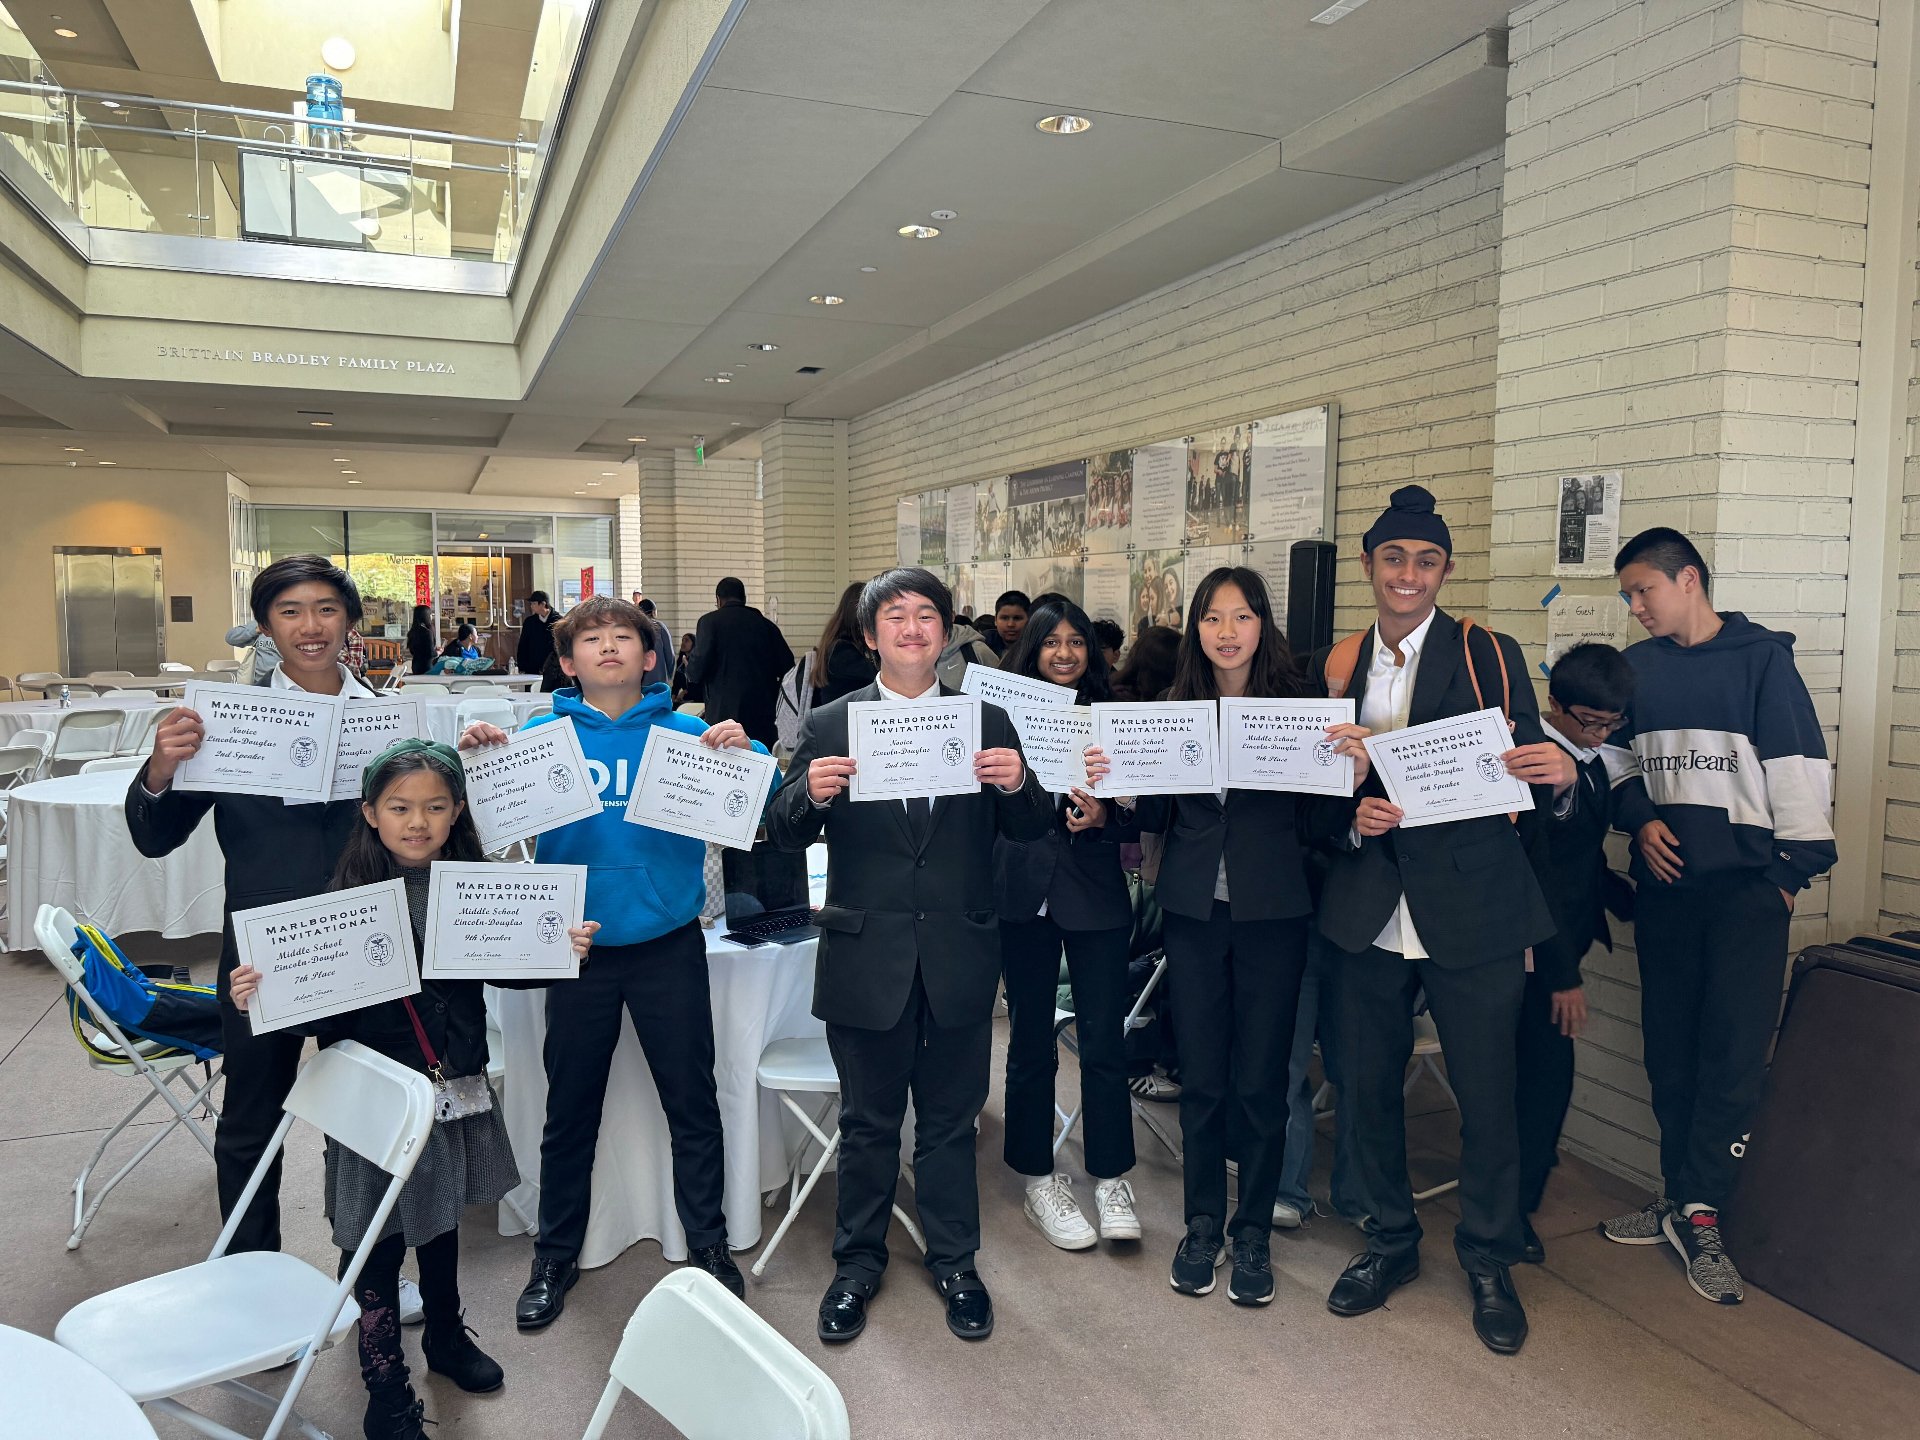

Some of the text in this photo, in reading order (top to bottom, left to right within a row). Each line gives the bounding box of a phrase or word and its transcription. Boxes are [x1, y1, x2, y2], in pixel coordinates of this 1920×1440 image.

[158, 346, 456, 374] BRITTAIN BRADLEY FAMILY PLAZA
[387, 556, 430, 564] Welcome
[1576, 606, 1595, 616] Guest
[212, 701, 314, 718] MARLBOROUGH
[214, 711, 310, 727] INVITATIONAL
[342, 714, 400, 724] BOROUGH
[872, 714, 958, 725] MARLBOROUGH
[1025, 716, 1092, 727] MARLBOROUG
[230, 726, 257, 735] Novice
[343, 724, 398, 733] ATIONAL
[874, 723, 955, 734] INVITATIONAL
[1026, 723, 1090, 735] INVITATIONA
[1245, 723, 1325, 731] INVITATIONAL
[206, 736, 277, 747] Lincoln-Douglas
[1242, 743, 1300, 751] Lincoln-Douglas
[1391, 730, 1482, 754] MARLBOROUGH
[872, 747, 930, 756] Lincoln-Douglas
[1398, 739, 1483, 761] INVITATIONAL
[232, 752, 265, 761] Speaker
[465, 741, 554, 775] MARLBOROUGH
[666, 747, 750, 774] MARLBOROUGH
[470, 752, 554, 782] INVITATIONAL
[667, 756, 745, 781] INVITATIONAL
[1405, 757, 1457, 772] Middle School
[678, 773, 700, 783] Novice
[1405, 767, 1464, 781] Lincoln-Douglas
[492, 778, 515, 790] Novice
[658, 778, 715, 796] Lincoln-Douglas
[1433, 781, 1460, 791] Speaker
[477, 782, 536, 806] Lincoln-Douglas
[496, 799, 527, 813] 1st Place
[677, 796, 703, 806] Speaker
[456, 882, 558, 891] MARLBOROUGH
[459, 892, 555, 901] INVITATIONAL
[266, 905, 378, 935] MARLBOROUGH
[453, 918, 523, 927] Lincoln-Douglas
[272, 916, 376, 945] INVITATIONAL
[480, 934, 511, 943] Speaker
[276, 938, 342, 960] Middle School
[273, 951, 349, 973] Lincoln-Douglas
[294, 969, 336, 984] 7th Place
